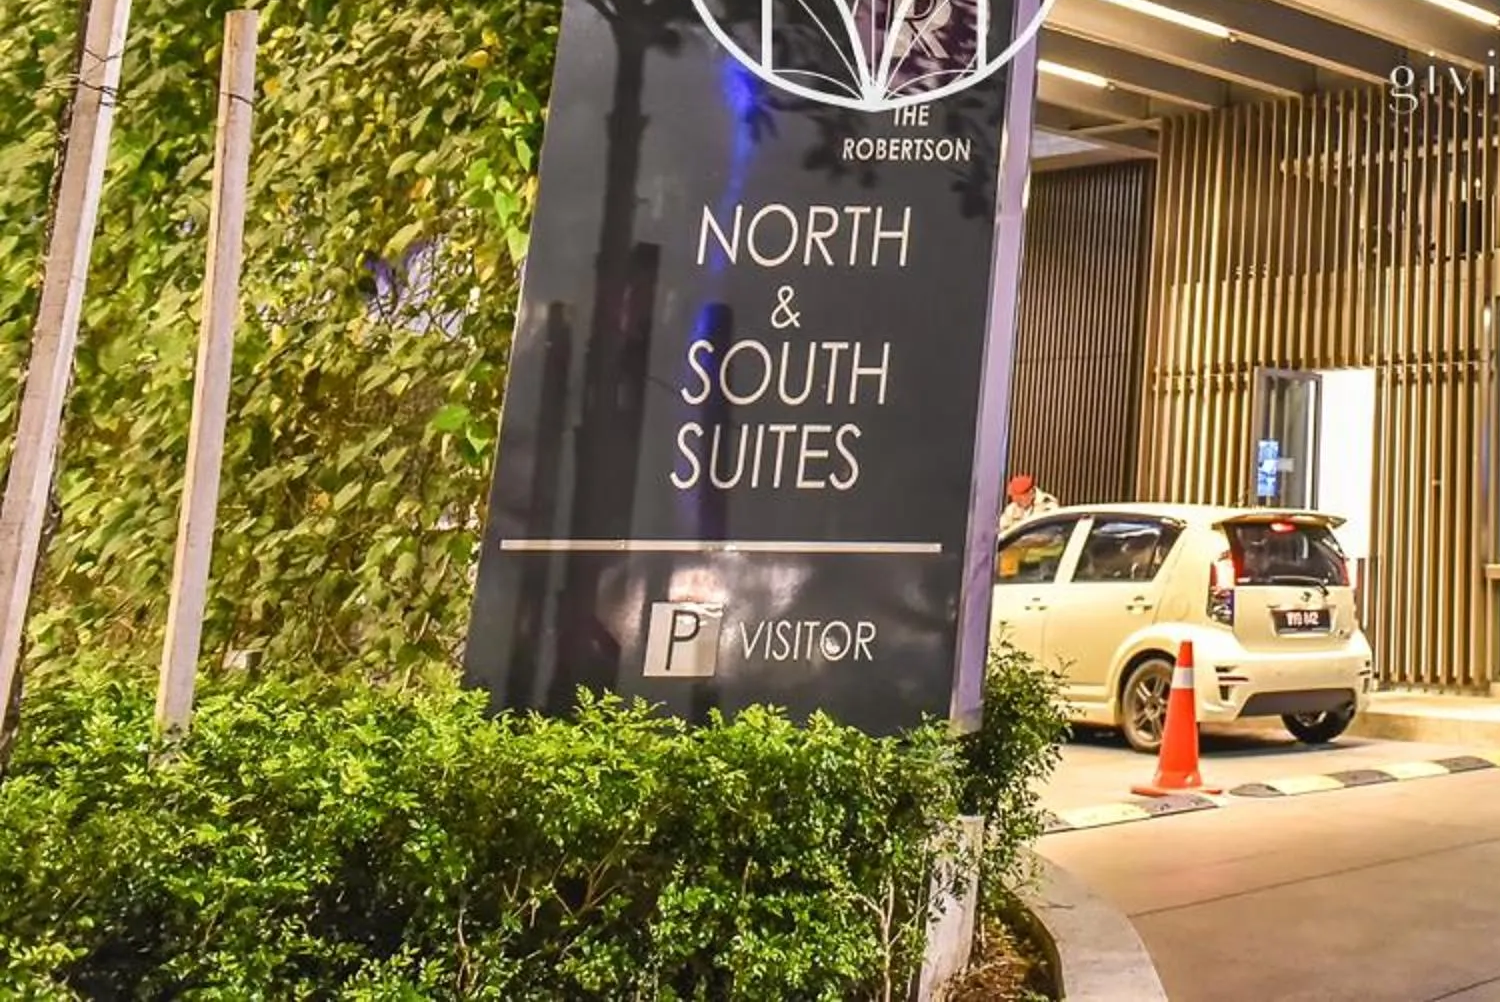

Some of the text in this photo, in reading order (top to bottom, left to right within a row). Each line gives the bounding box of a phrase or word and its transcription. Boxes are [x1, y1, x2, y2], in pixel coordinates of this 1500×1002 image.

[892, 104, 930, 127] THE
[842, 137, 971, 162] ROBERTSON
[696, 203, 912, 267] NORTH
[770, 285, 801, 329] &
[680, 339, 890, 405] SOUTH
[670, 422, 862, 490] SUITES
[665, 609, 877, 671] P VISITOR
